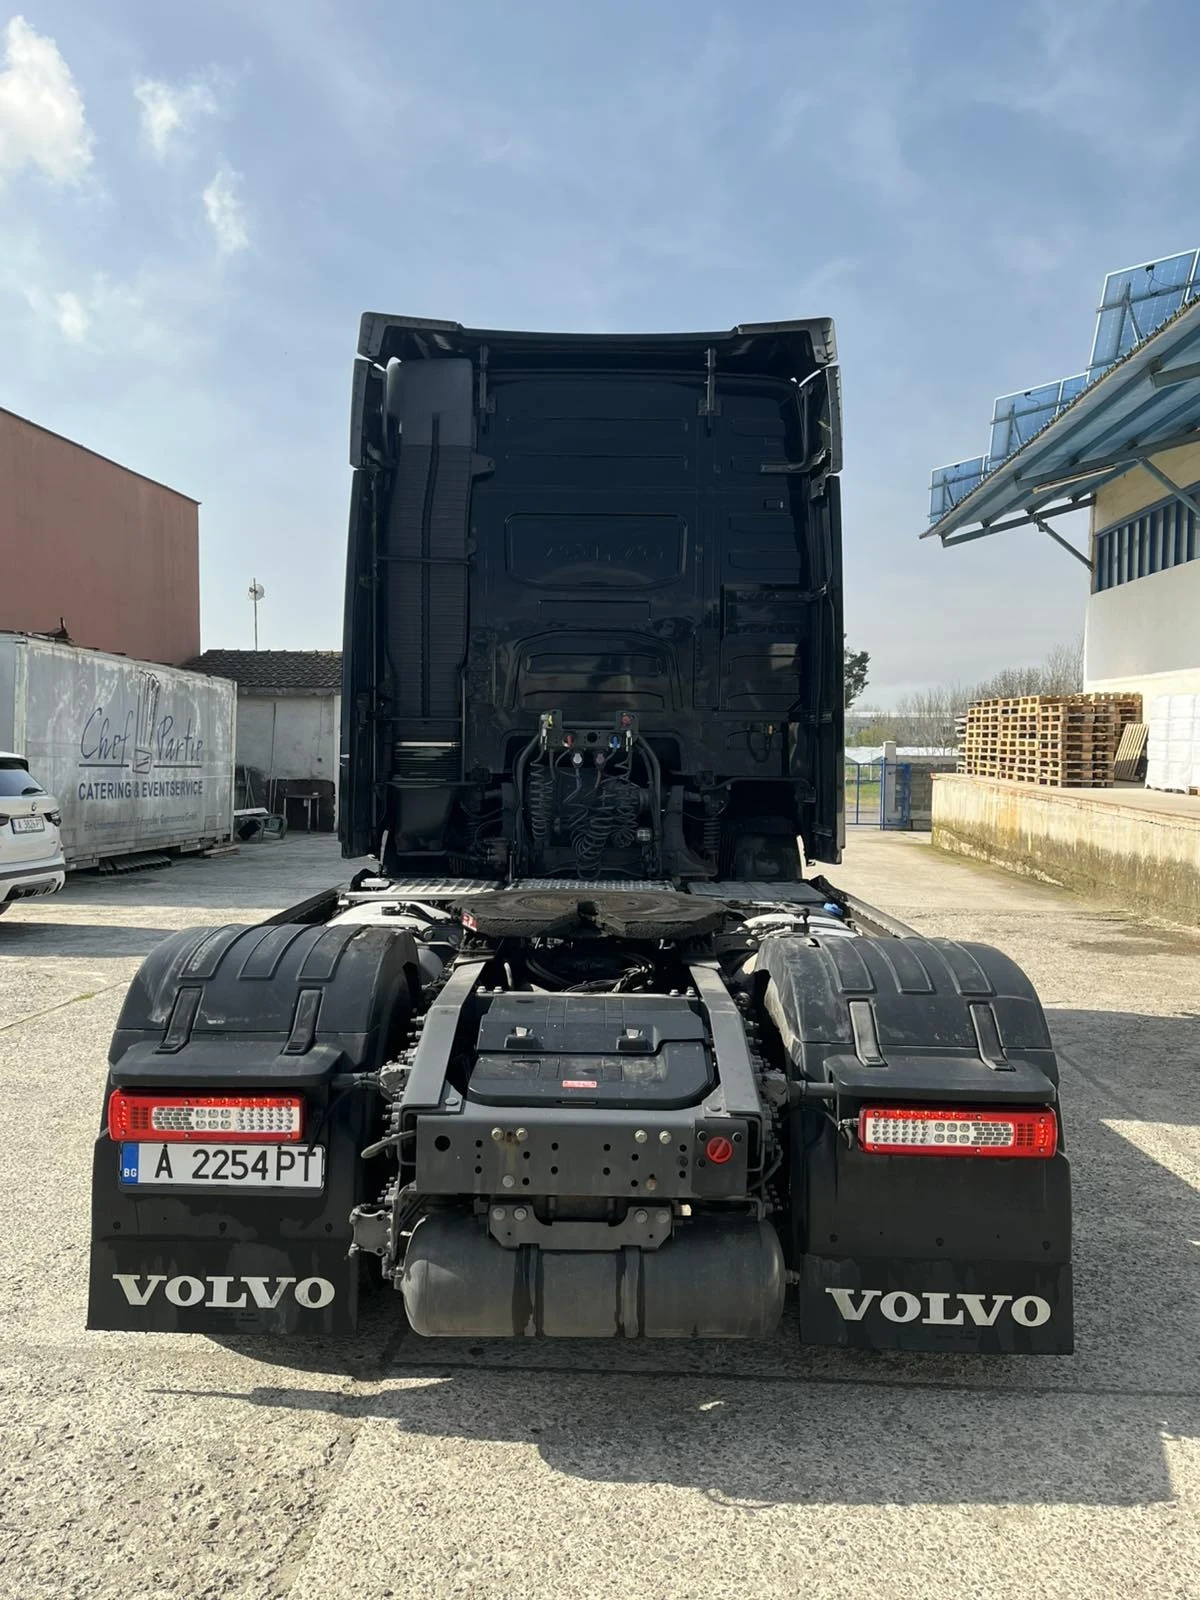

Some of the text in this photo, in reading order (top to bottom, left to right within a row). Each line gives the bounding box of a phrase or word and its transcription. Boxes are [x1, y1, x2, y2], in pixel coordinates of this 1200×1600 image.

[81, 707, 203, 765] Chef Partie
[78, 780, 203, 800] CATERING & EVENTSERVICE
[123, 1168, 137, 1178] BG
[154, 1146, 174, 1179] A
[112, 1273, 336, 1310] VOLVO
[825, 1287, 1051, 1328] VOLVO
